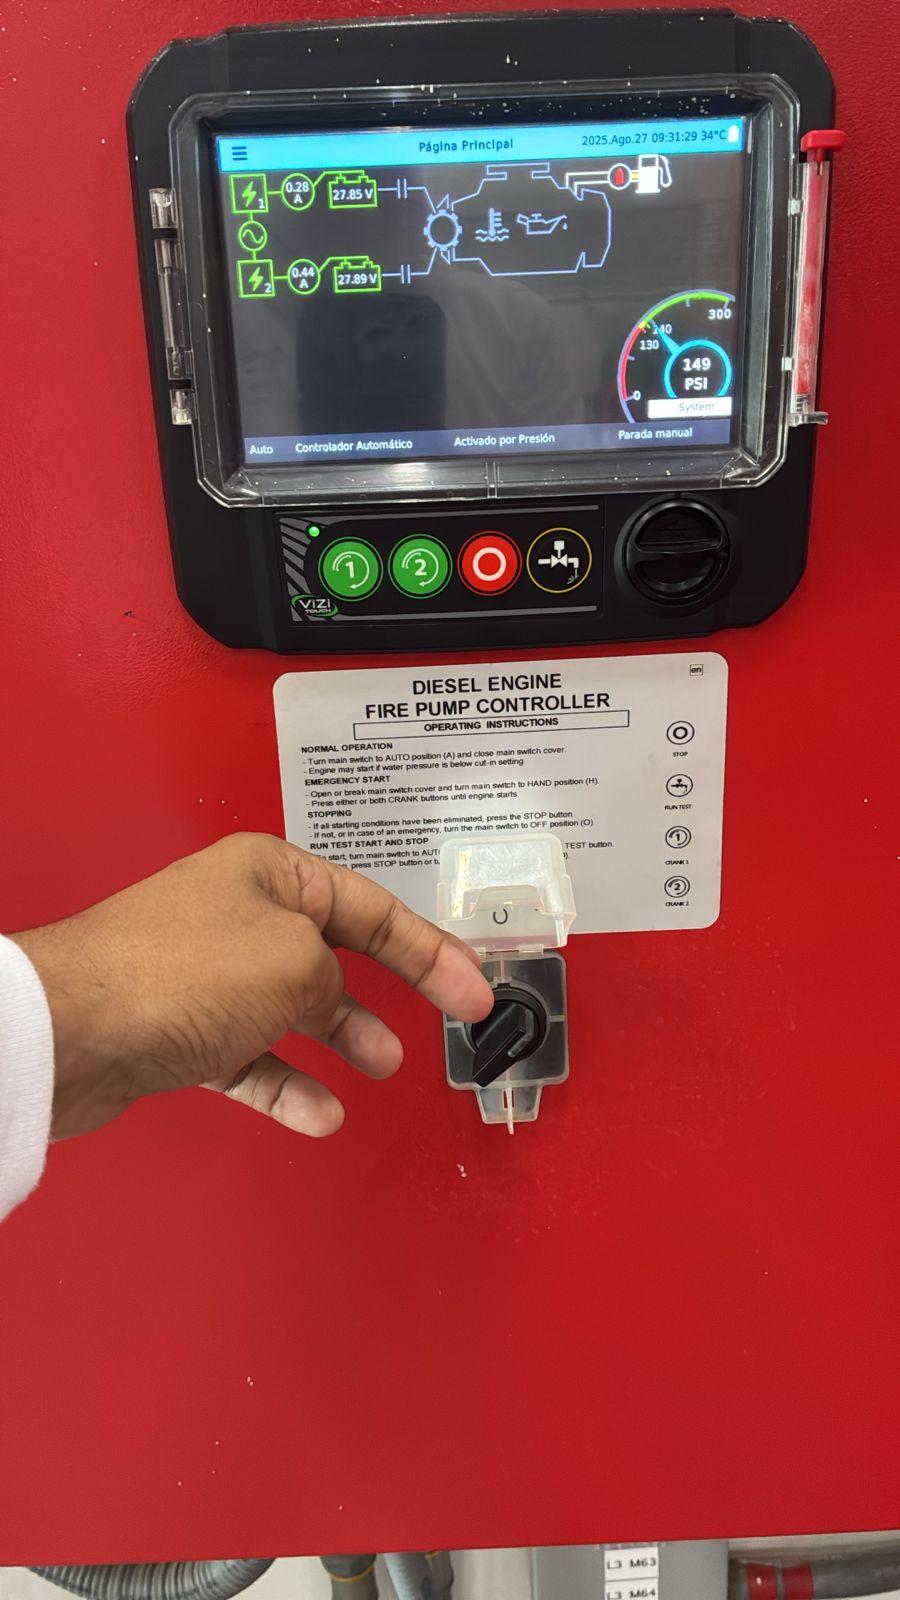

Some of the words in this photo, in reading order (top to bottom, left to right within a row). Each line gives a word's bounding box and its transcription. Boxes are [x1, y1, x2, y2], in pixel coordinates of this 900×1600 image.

[582, 133, 647, 146] 2025.Ago.27
[652, 131, 697, 144] 09:31:29
[701, 130, 726, 141] 34°C
[419, 140, 458, 153] Página
[462, 138, 513, 153] Principal
[285, 181, 309, 193] 0.28
[294, 194, 303, 204] A
[333, 188, 363, 200] 27.85
[364, 188, 373, 199] V
[258, 198, 265, 209] 1
[292, 267, 315, 279] 0.44
[338, 273, 368, 285] 27.89
[368, 273, 378, 284] V
[264, 283, 272, 293] 2
[299, 279, 309, 289] A
[708, 308, 732, 320] 300
[640, 340, 659, 350] 130
[682, 357, 711, 372] 149
[685, 377, 708, 390] PSI
[633, 390, 641, 400] 0
[679, 402, 715, 412] System
[454, 436, 497, 447] Activado
[500, 436, 516, 448] por
[518, 432, 555, 445] Presión
[619, 430, 653, 441] Parada
[656, 428, 693, 439] manual
[250, 444, 273, 455] Auto
[295, 440, 354, 452] Controlador
[356, 437, 413, 451] Automático
[346, 561, 354, 578] 1
[415, 559, 427, 576] 2
[412, 678, 481, 696] DIESEL
[488, 673, 562, 691] ENGINE
[365, 703, 409, 719] FIRE
[416, 700, 470, 717] PUMP
[476, 693, 610, 713] CONTROLLER
[424, 722, 481, 732] OPERATING
[487, 718, 559, 729] INSTRUCTIONS
[300, 745, 339, 753] NORMAL
[340, 743, 393, 752] OPERATION
[307, 757, 326, 766] Turn
[327, 756, 347, 765] main
[348, 755, 374, 764] switch
[374, 755, 383, 763] to
[384, 754, 410, 762] AUTO
[411, 752, 441, 763] position
[442, 752, 455, 761] (A)
[456, 751, 472, 759] and
[473, 750, 494, 758] close
[495, 749, 515, 757] main
[516, 747, 541, 756] switch
[308, 766, 336, 776] Engine
[337, 767, 354, 775] may
[356, 765, 374, 773] start
[375, 764, 380, 772] if
[381, 763, 404, 772] water
[405, 763, 439, 772] pressure
[441, 761, 448, 769] is
[449, 760, 472, 769] below
[474, 759, 496, 768] cut-in
[304, 776, 360, 786] EMERGENCY
[361, 775, 391, 784] START
[310, 789, 332, 799] Open
[343, 788, 366, 796] break
[367, 787, 387, 795] main
[388, 786, 413, 794] switch
[437, 784, 452, 792] and
[453, 783, 469, 791] turn
[471, 782, 490, 791] main
[491, 781, 516, 790] switch
[517, 780, 525, 788] to
[526, 779, 552, 788] HAND
[553, 777, 583, 788] position
[311, 799, 334, 807] Press
[335, 798, 358, 806] either
[369, 797, 386, 805] both
[387, 795, 418, 804] CRANK
[420, 794, 448, 803] buttons
[450, 793, 466, 801] until
[467, 792, 494, 801] engine
[307, 809, 352, 818] STOPPING
[312, 822, 318, 830] If
[320, 822, 330, 830] all
[330, 821, 359, 830] starting
[360, 819, 400, 828] conditions
[401, 818, 421, 826] have
[422, 817, 442, 825] been
[443, 815, 484, 825] eliminated,
[486, 816, 507, 824] press
[509, 813, 521, 821] the
[523, 812, 547, 821] STOP
[313, 831, 319, 839] If
[320, 831, 336, 840] not,
[347, 830, 355, 838] in
[397, 828, 441, 836] emergency,
[443, 825, 459, 833] turn
[460, 824, 473, 833] the
[474, 823, 493, 832] main
[495, 822, 519, 831] switch
[520, 822, 528, 830] to
[529, 821, 547, 829] OFF
[549, 819, 578, 830] position
[309, 841, 328, 850] RUN
[330, 840, 353, 849] TEST
[354, 839, 383, 848] START
[384, 838, 403, 846] AND
[405, 837, 429, 846] STOP
[565, 841, 586, 850] TEST
[328, 853, 347, 863] start,
[349, 852, 364, 861] turn
[366, 852, 385, 860] main
[387, 850, 410, 859] switch
[412, 850, 420, 858] to
[351, 863, 372, 871] press
[374, 860, 397, 868] STOP
[399, 858, 423, 867] button
[607, 1560, 622, 1570] L3
[630, 1558, 656, 1567] M63
